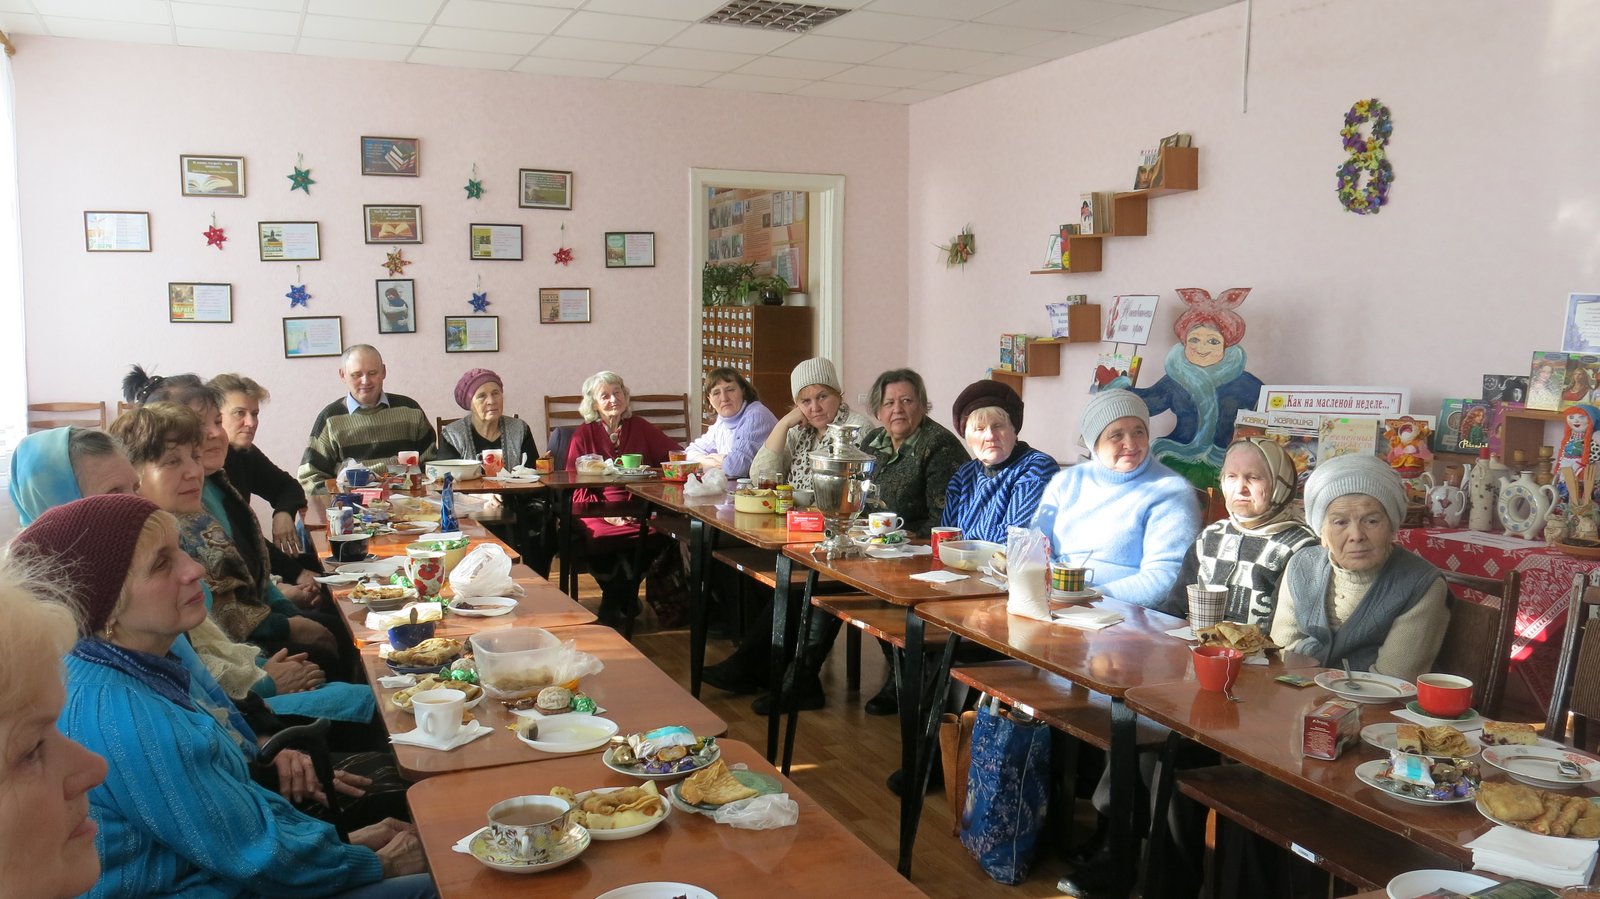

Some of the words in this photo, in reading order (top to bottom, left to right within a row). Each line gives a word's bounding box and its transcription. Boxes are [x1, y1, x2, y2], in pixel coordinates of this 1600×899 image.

[1336, 98, 1395, 215] 8
[1304, 399, 1314, 408] на
[1316, 396, 1353, 409] масленой
